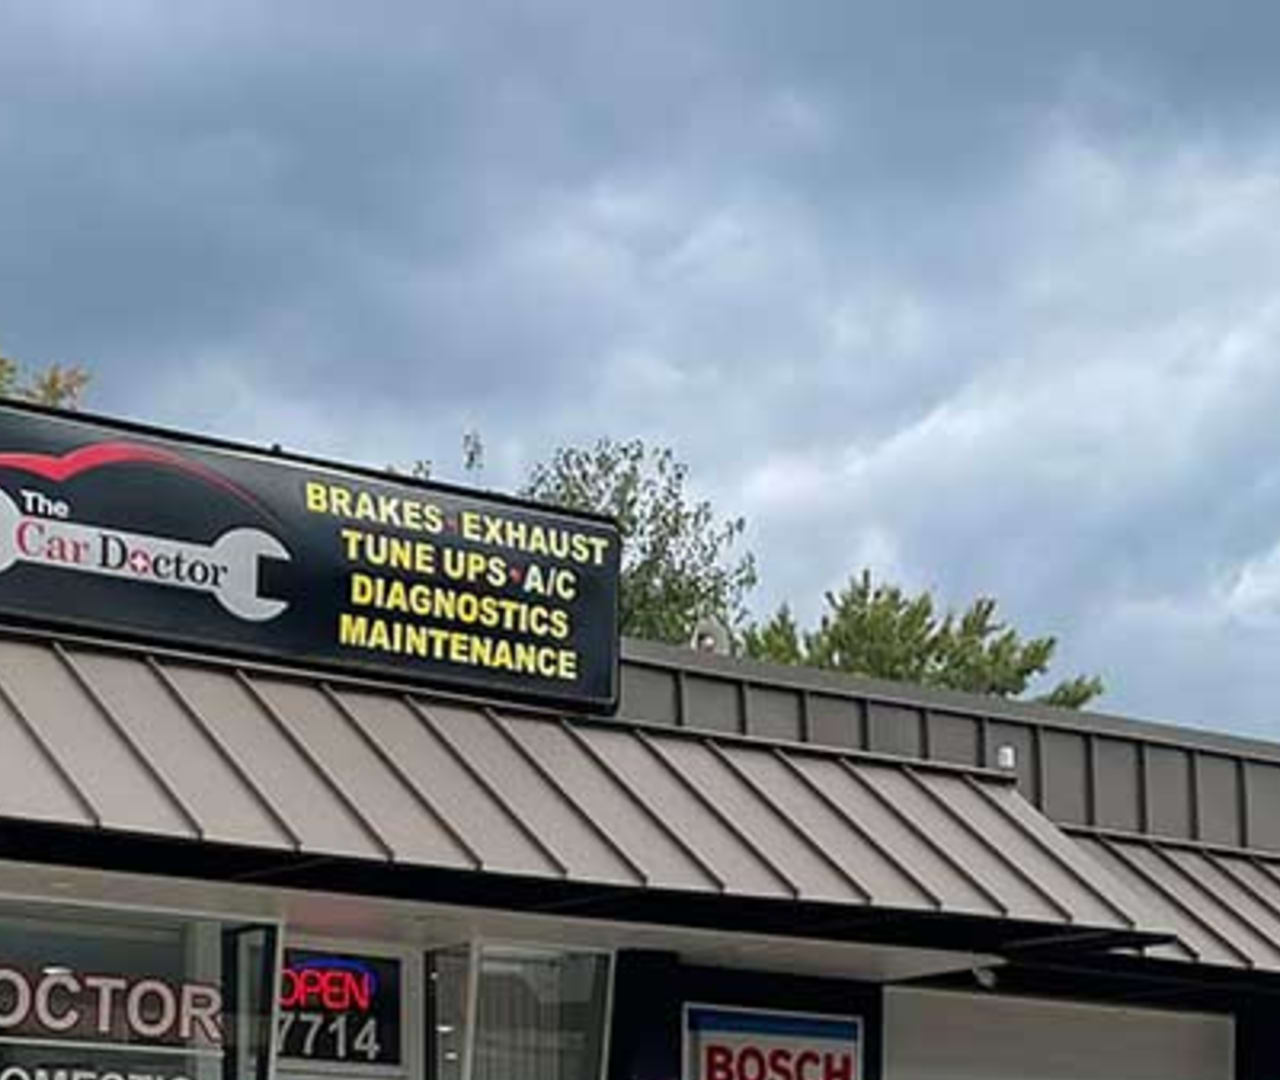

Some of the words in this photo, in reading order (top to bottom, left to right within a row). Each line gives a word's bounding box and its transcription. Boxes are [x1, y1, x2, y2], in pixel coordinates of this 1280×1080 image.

[21, 489, 69, 519] The
[306, 482, 441, 535] BRAKES
[462, 513, 608, 566] EXHAUST
[15, 521, 90, 564] Car
[98, 535, 229, 588] Doctor
[342, 529, 434, 577] TUNE
[443, 543, 506, 588] UPS
[523, 555, 575, 601] A/C
[351, 574, 568, 640] DIAGNOSTICS
[339, 614, 576, 681] MAINTENANCE
[279, 968, 372, 1010] OPEN
[277, 1011, 381, 1061] 7714
